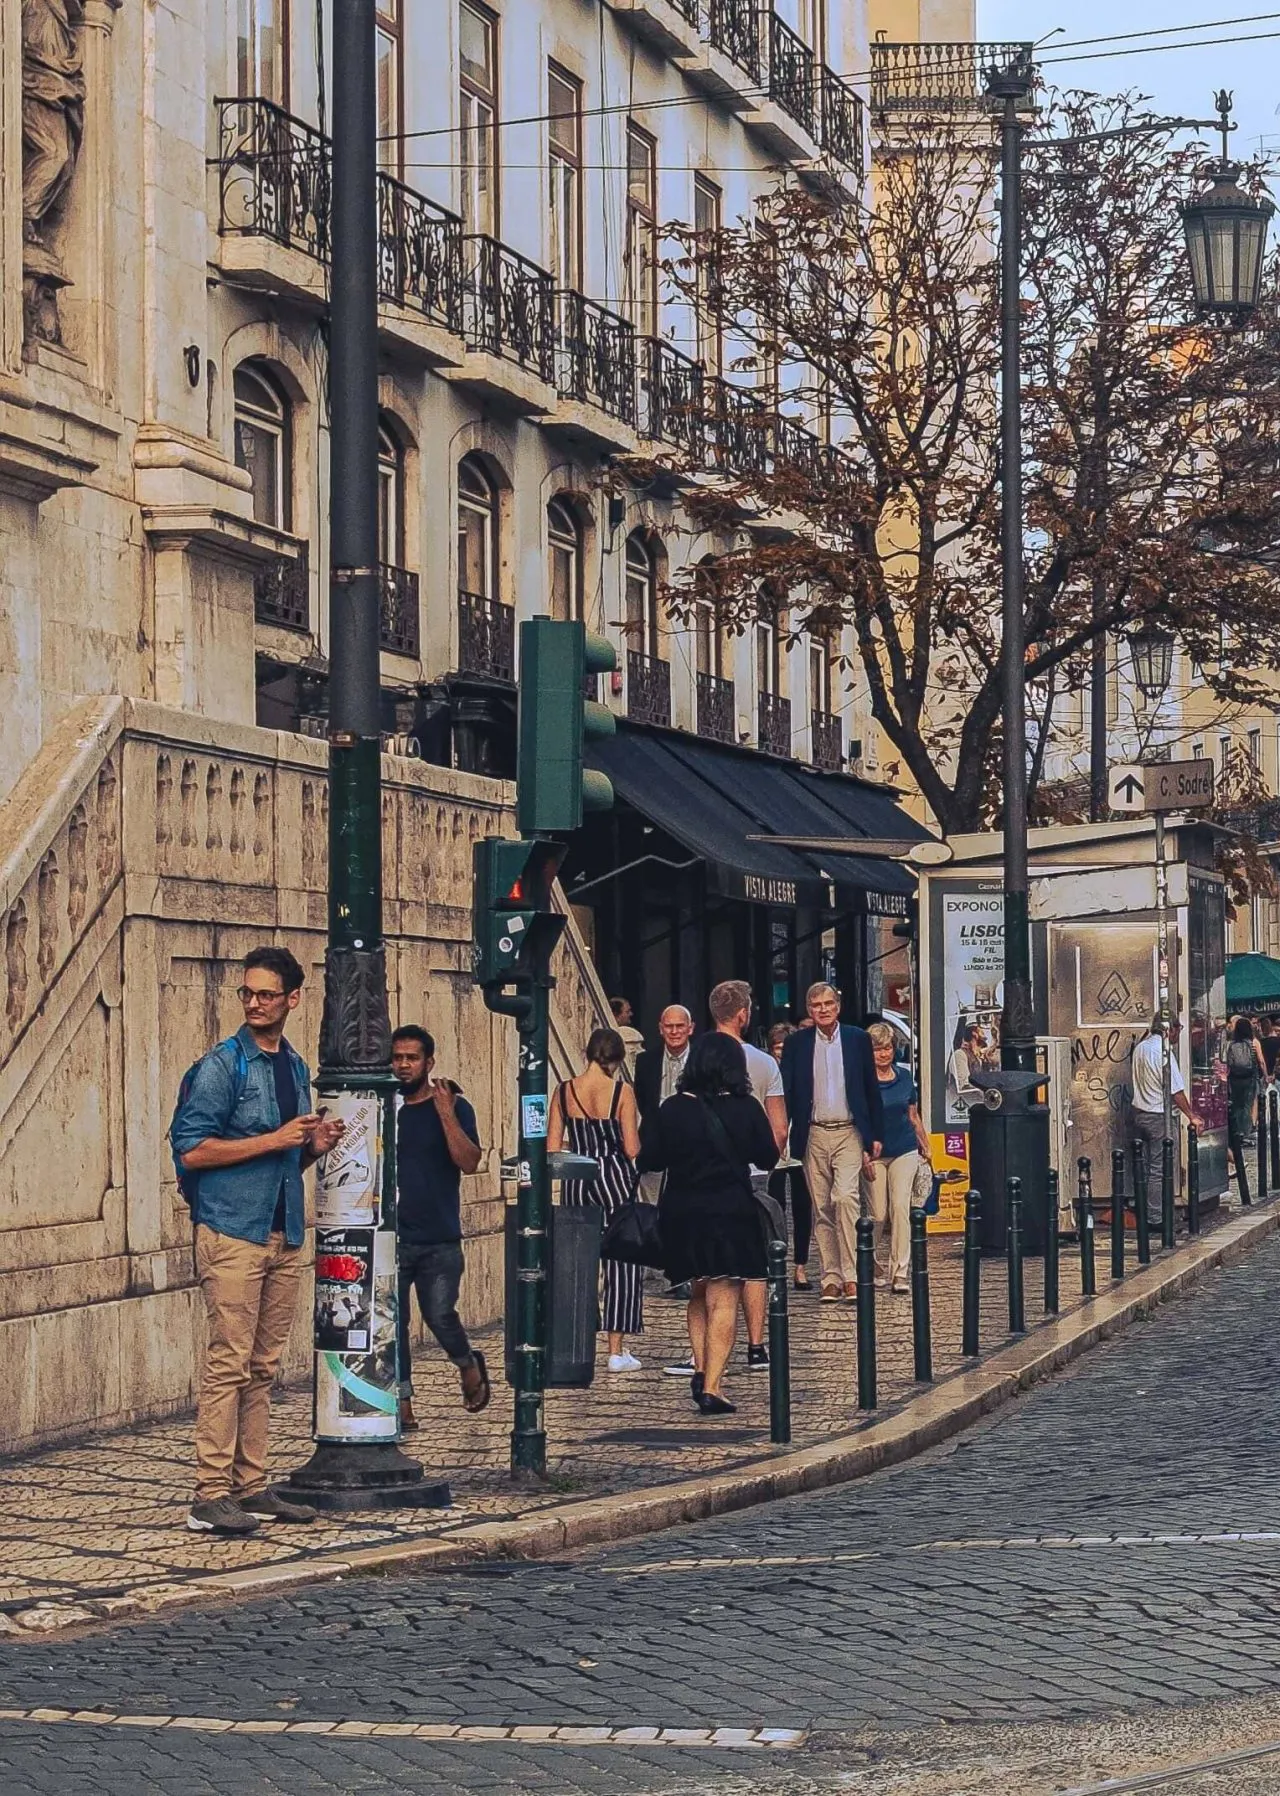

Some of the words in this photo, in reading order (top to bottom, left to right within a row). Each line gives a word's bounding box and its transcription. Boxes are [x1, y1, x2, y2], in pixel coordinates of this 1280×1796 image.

[1160, 775, 1172, 797] C.
[1177, 772, 1209, 796] Sodré
[744, 875, 766, 899] VISTA
[768, 880, 797, 904] ALEGRE
[866, 891, 883, 912] VISTA
[947, 901, 1003, 912] EXPONO
[960, 924, 1006, 938] LISBO
[343, 1124, 369, 1153] MORADA
